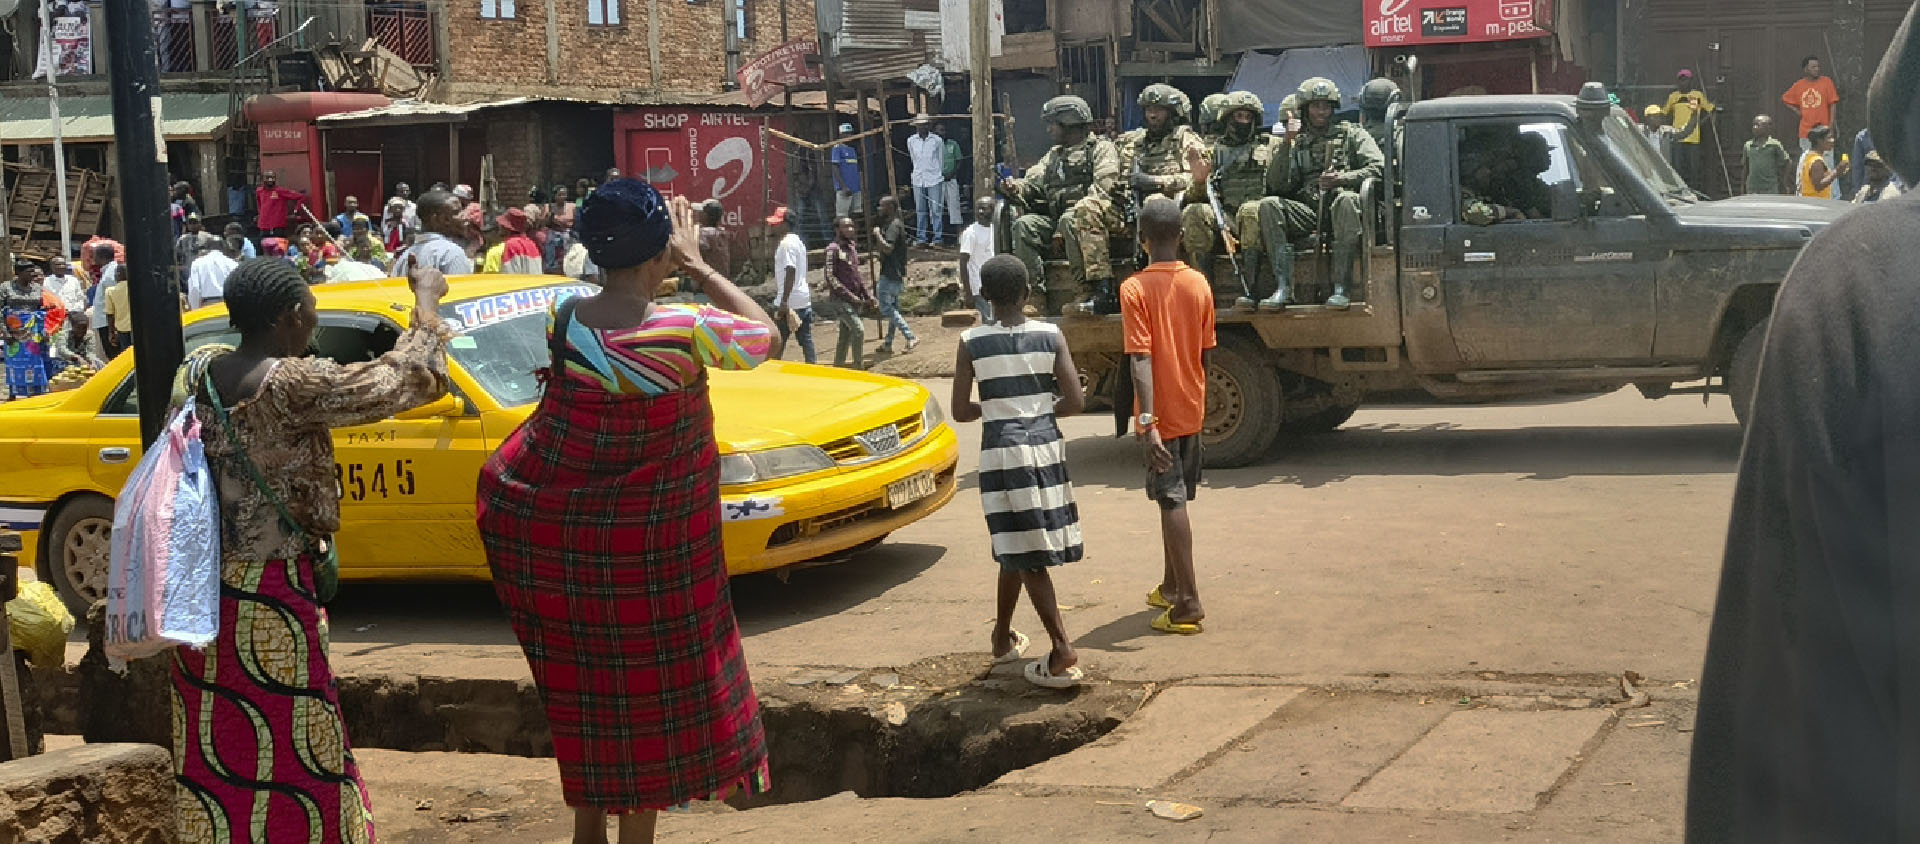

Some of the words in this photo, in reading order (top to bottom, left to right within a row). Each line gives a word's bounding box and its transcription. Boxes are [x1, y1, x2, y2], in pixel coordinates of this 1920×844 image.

[1371, 14, 1412, 35] airtel
[644, 113, 689, 128] SHOP
[701, 113, 750, 126] AIRTEL
[688, 128, 699, 177] DEPOT
[347, 430, 396, 444] TAXI
